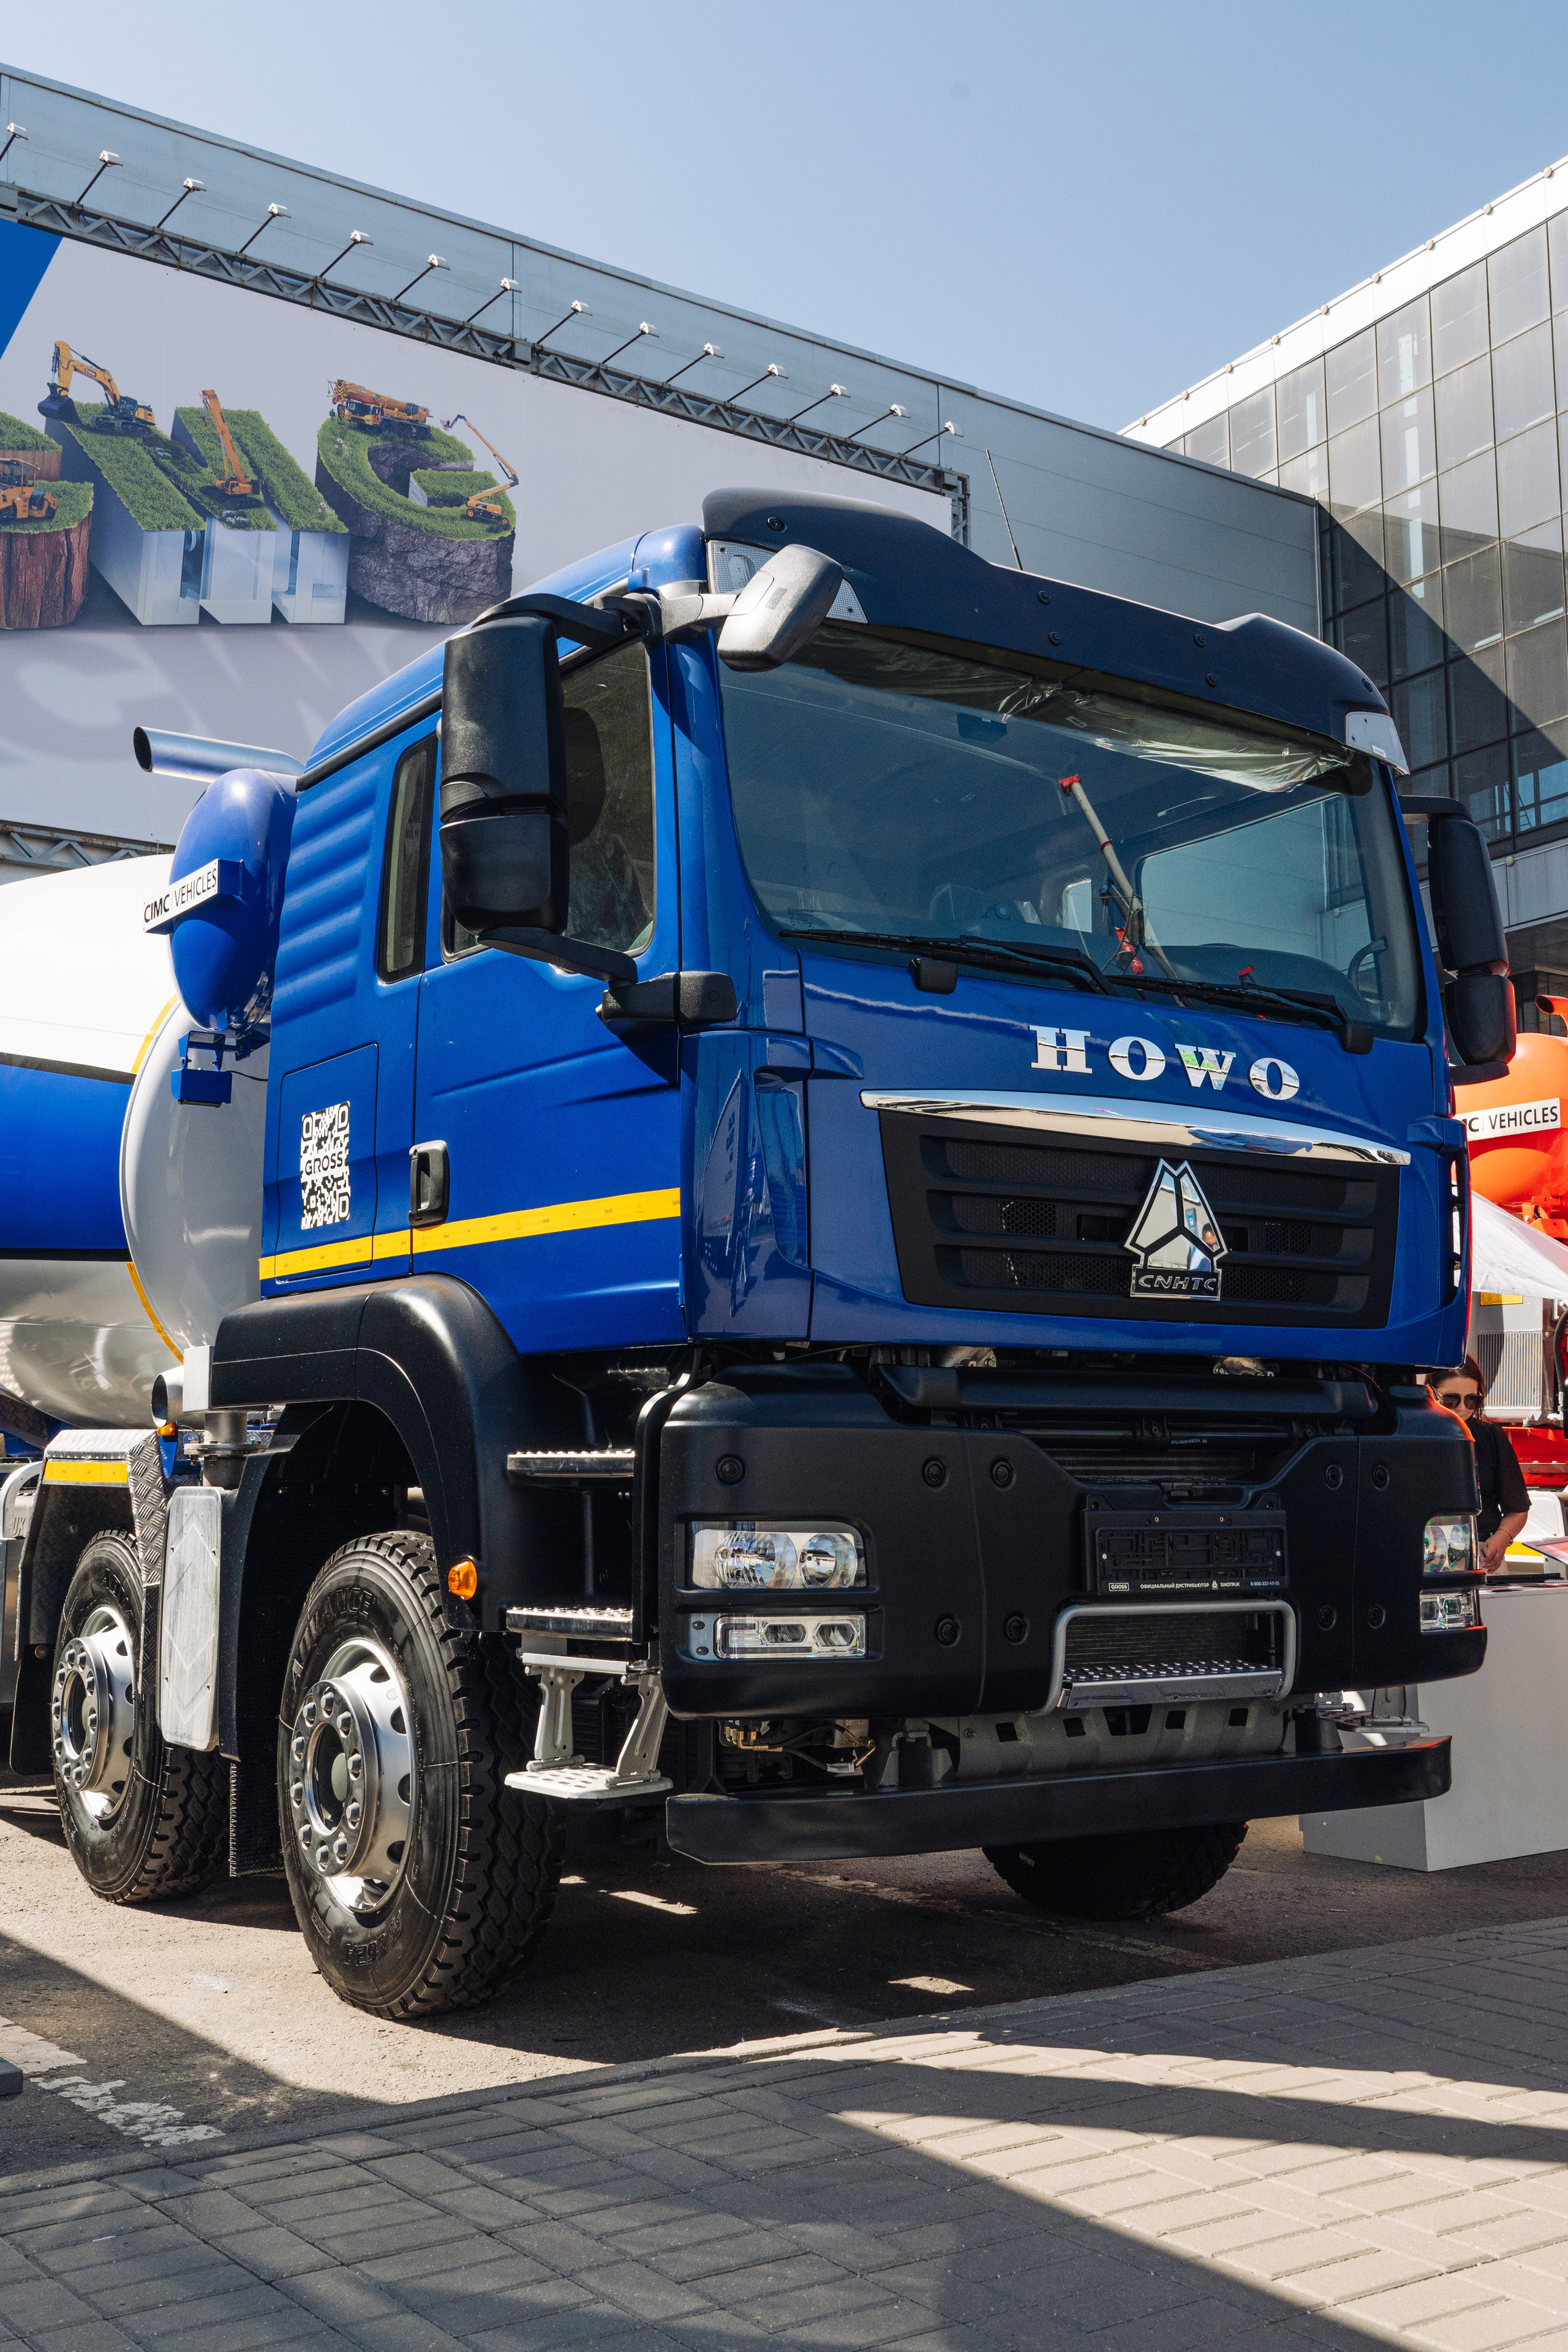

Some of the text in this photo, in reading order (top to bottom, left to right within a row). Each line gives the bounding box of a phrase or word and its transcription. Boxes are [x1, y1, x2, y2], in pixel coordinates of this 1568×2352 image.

[144, 867, 217, 923] CIMC VEHICLES
[1028, 1025, 1300, 1101] HOWO
[1488, 1106, 1558, 1129] VEHICLES
[305, 1151, 343, 1175] GROSS
[1138, 1275, 1216, 1291] CNHTC
